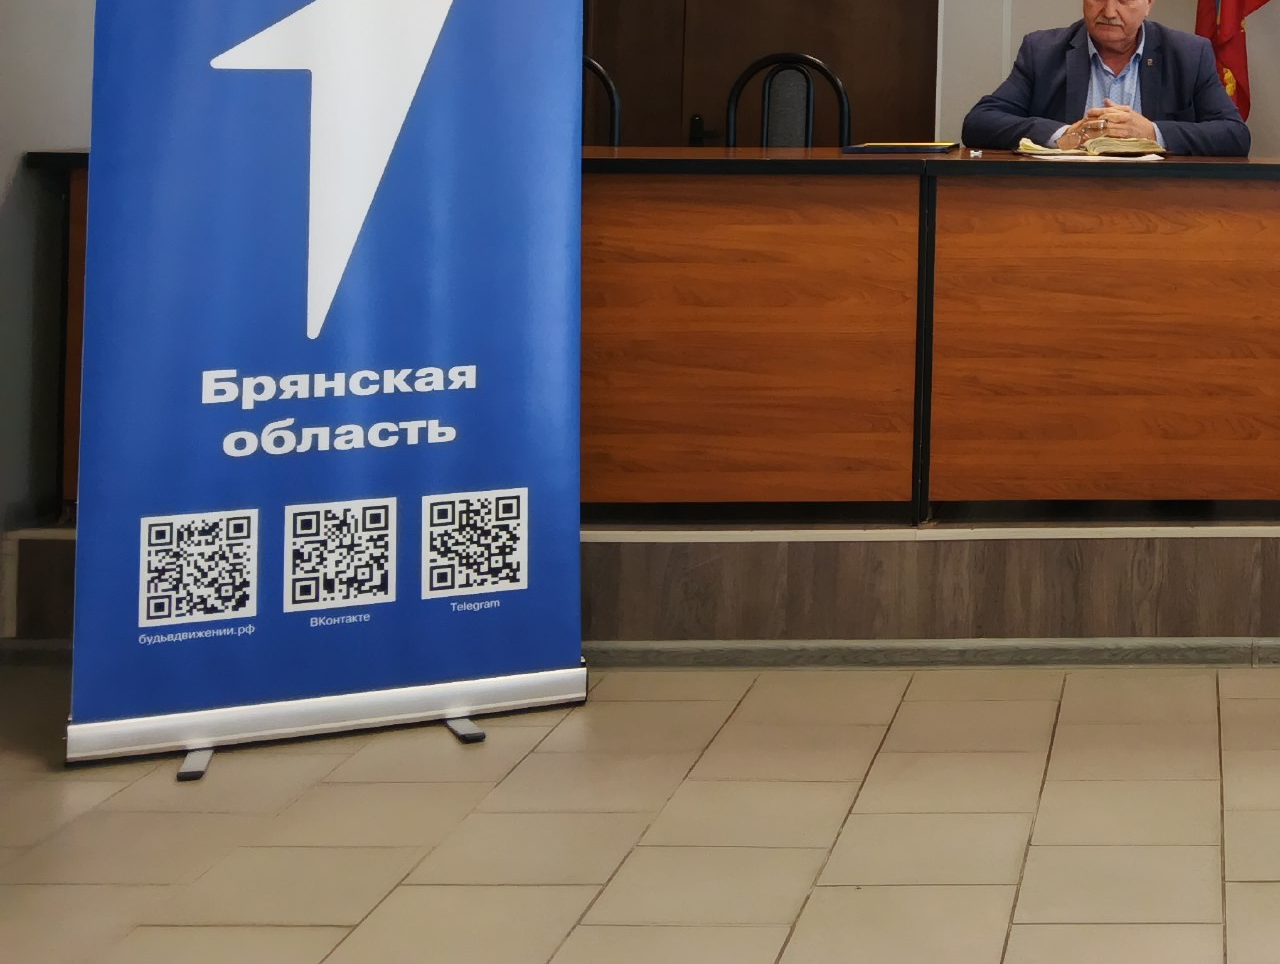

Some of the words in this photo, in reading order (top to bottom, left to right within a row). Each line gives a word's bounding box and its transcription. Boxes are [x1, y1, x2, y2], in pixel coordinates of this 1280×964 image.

[201, 364, 478, 410] Брянская
[222, 417, 458, 458] область
[450, 599, 501, 612] Telegram
[309, 613, 371, 627] ВКонтакте
[138, 624, 256, 646] будьвдвижении.рф
